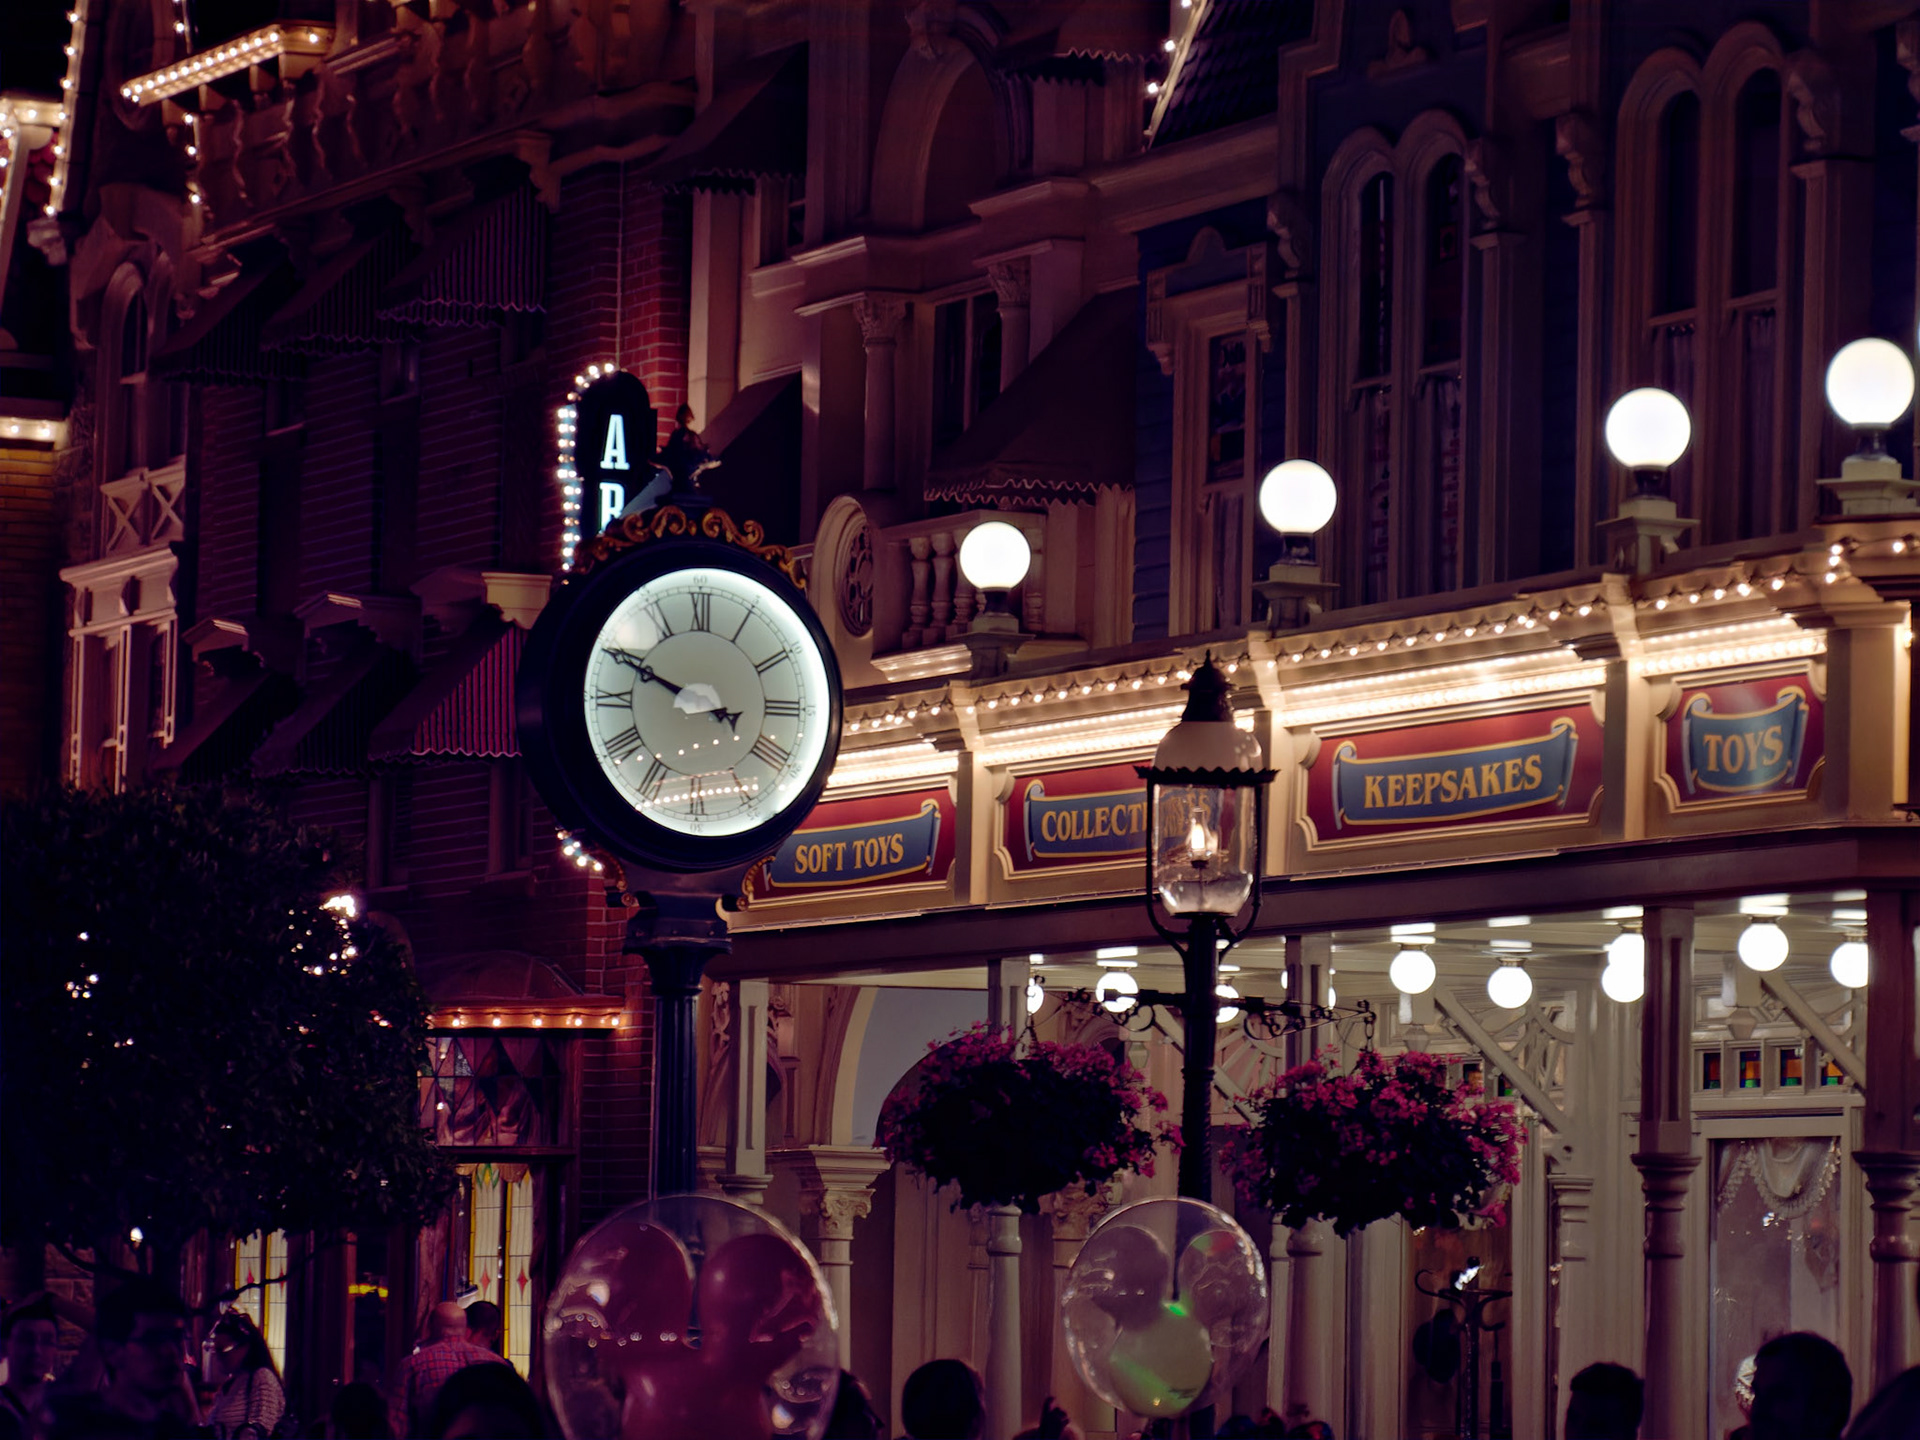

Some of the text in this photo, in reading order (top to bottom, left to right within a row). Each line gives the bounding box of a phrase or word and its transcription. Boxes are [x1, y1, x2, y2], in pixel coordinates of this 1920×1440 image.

[693, 575, 708, 585] 60
[690, 593, 711, 632] XII
[754, 648, 791, 674] II
[596, 689, 633, 709] IX
[764, 700, 800, 717] III
[1703, 725, 1784, 774] TOYS
[1364, 754, 1543, 809] KEEPSAKES
[794, 833, 905, 875] SOFT TOYS
